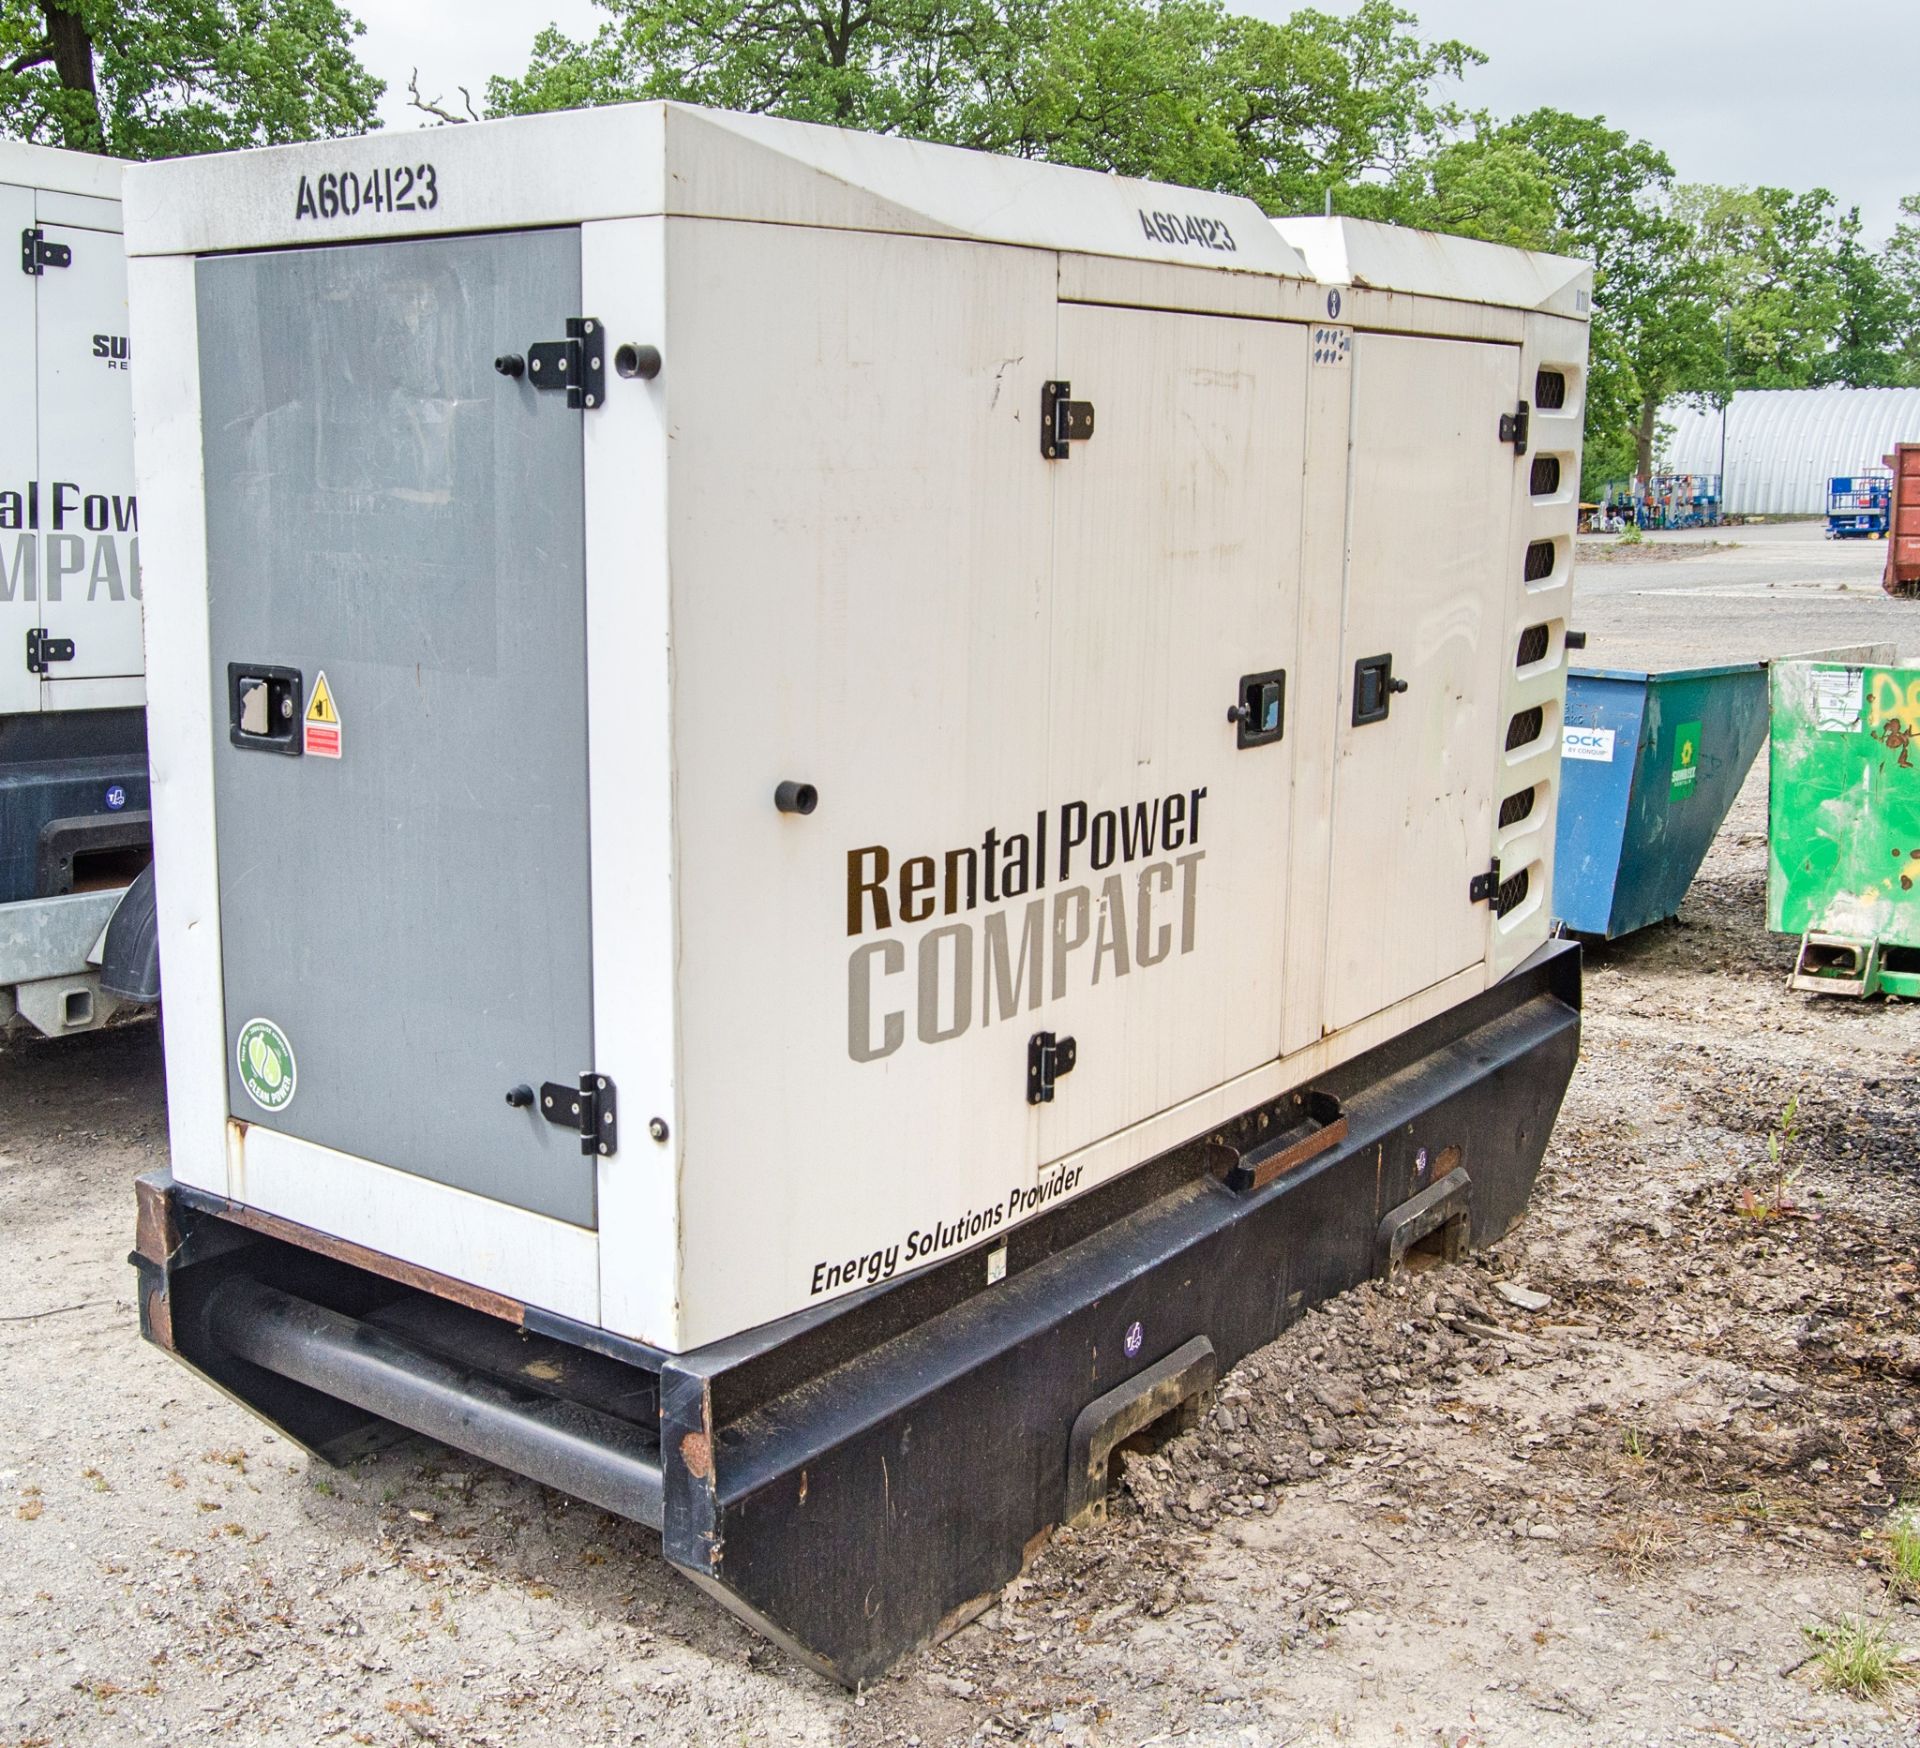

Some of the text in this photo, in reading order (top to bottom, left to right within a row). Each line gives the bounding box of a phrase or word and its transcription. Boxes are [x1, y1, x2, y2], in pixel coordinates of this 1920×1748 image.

[295, 163, 438, 220] A604123
[1138, 208, 1237, 252] A604123
[93, 334, 131, 360] SU
[1562, 734, 1603, 747] OCK
[846, 786, 1208, 937] Rental Power
[847, 849, 1206, 1064] COMPACT
[810, 1164, 1084, 1296] Energy Solutions Provider
